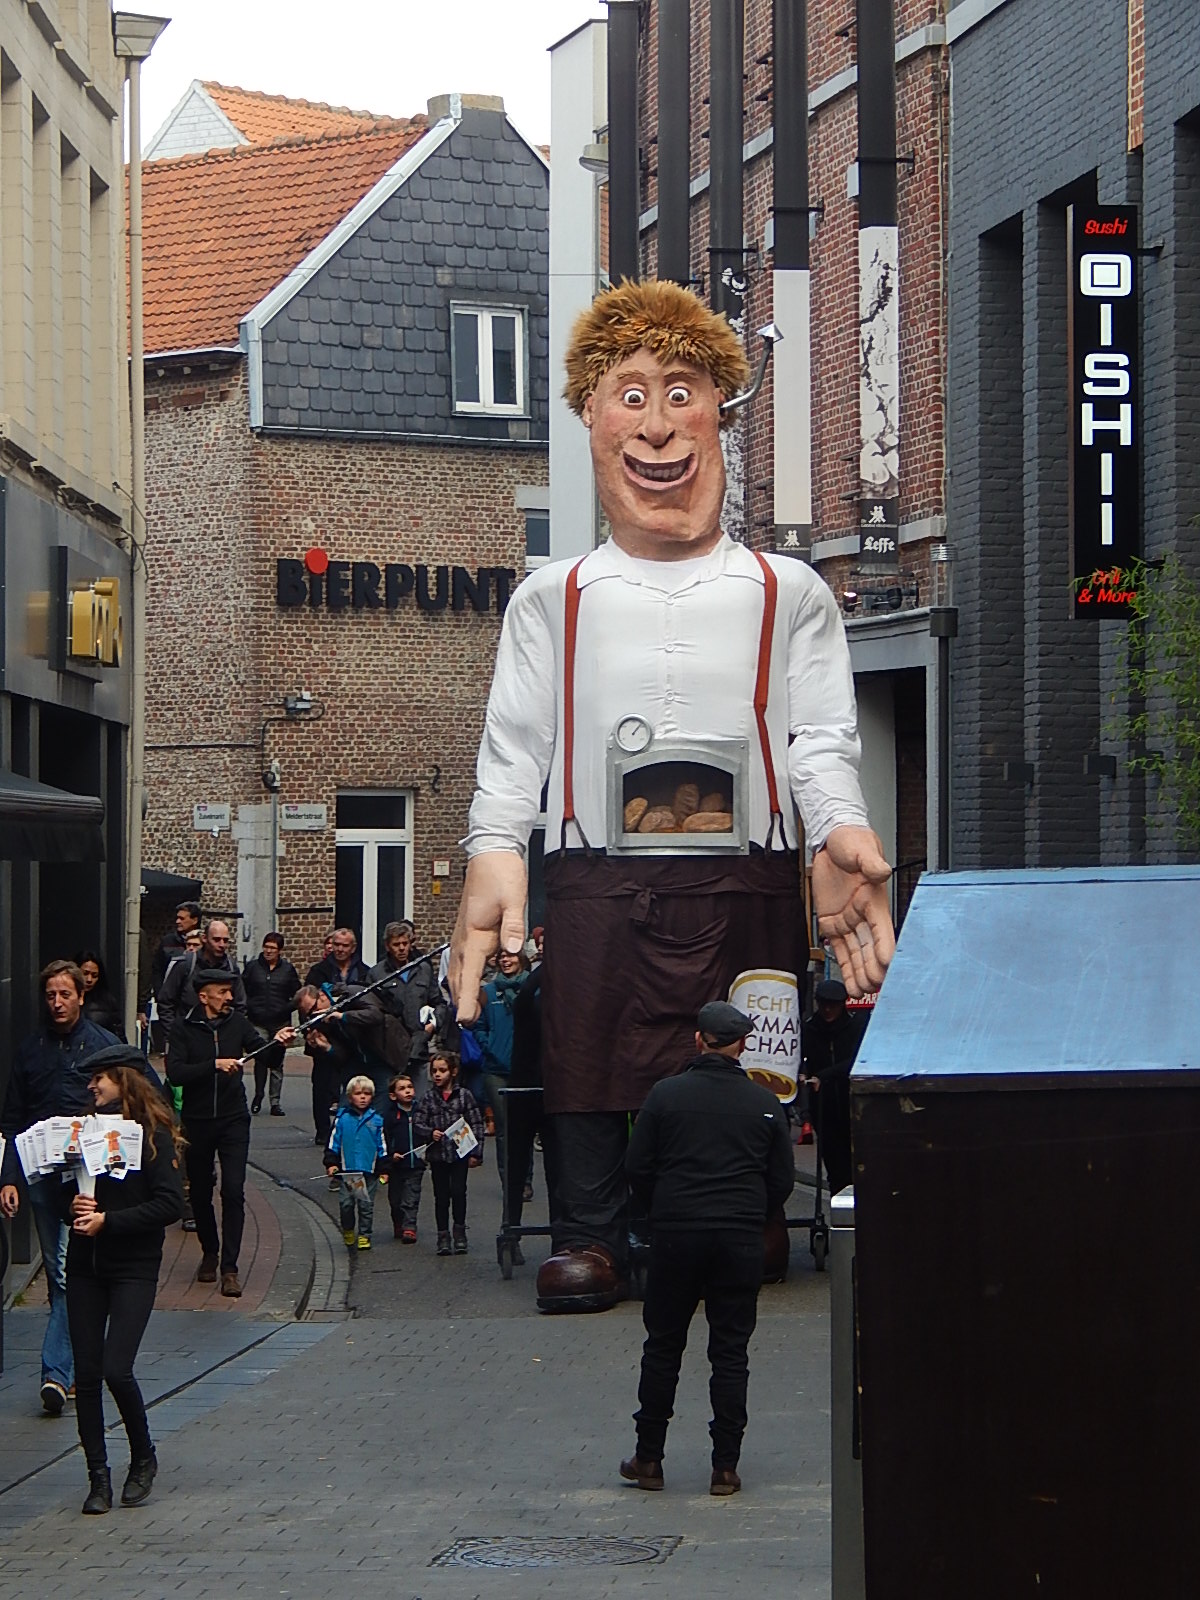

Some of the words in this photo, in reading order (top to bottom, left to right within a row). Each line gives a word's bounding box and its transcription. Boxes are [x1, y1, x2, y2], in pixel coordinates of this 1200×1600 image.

[1084, 217, 1129, 235] Sushi
[1080, 253, 1132, 546] OISHII
[863, 536, 896, 553] Leffe
[1078, 588, 1094, 603] &
[746, 993, 793, 1014] ECHT
